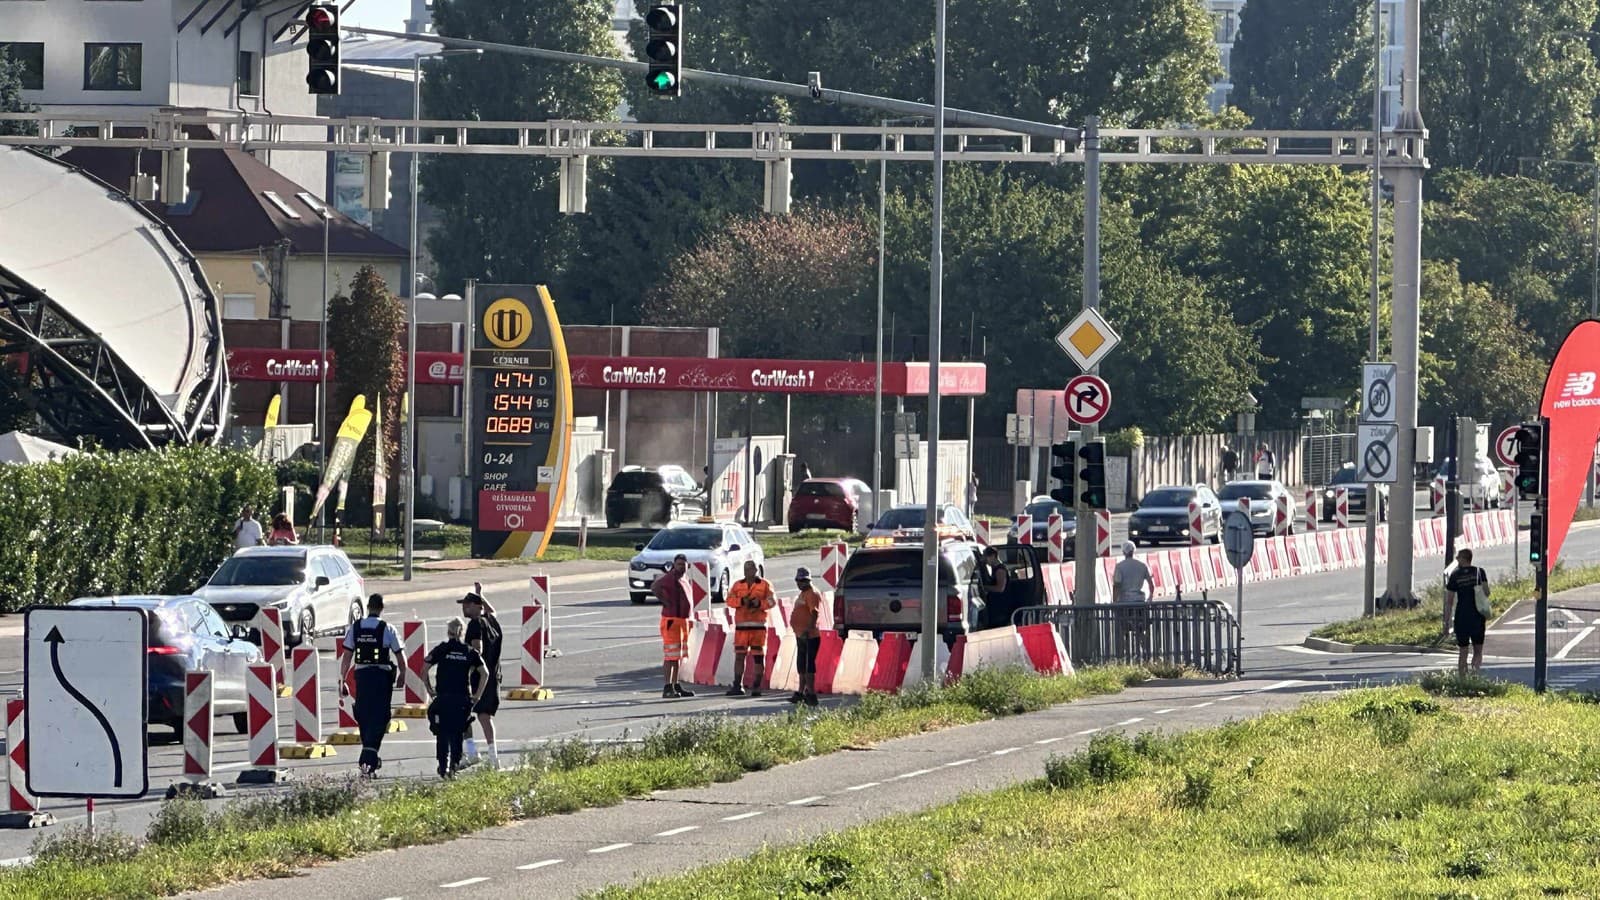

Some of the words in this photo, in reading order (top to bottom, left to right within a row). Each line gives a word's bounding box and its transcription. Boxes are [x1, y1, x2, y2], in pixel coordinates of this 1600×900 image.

[266, 358, 319, 377] CarWash
[602, 365, 657, 385] CarWash
[657, 367, 667, 384] 2
[751, 368, 807, 387] CarWash
[808, 369, 815, 387] 1
[538, 376, 547, 386] D
[1372, 387, 1386, 407] 30
[535, 398, 550, 408] 95
[1553, 400, 1571, 409] new
[483, 452, 514, 465] 0-24
[483, 472, 509, 480] SHOP
[483, 483, 507, 492] CAFÉ
